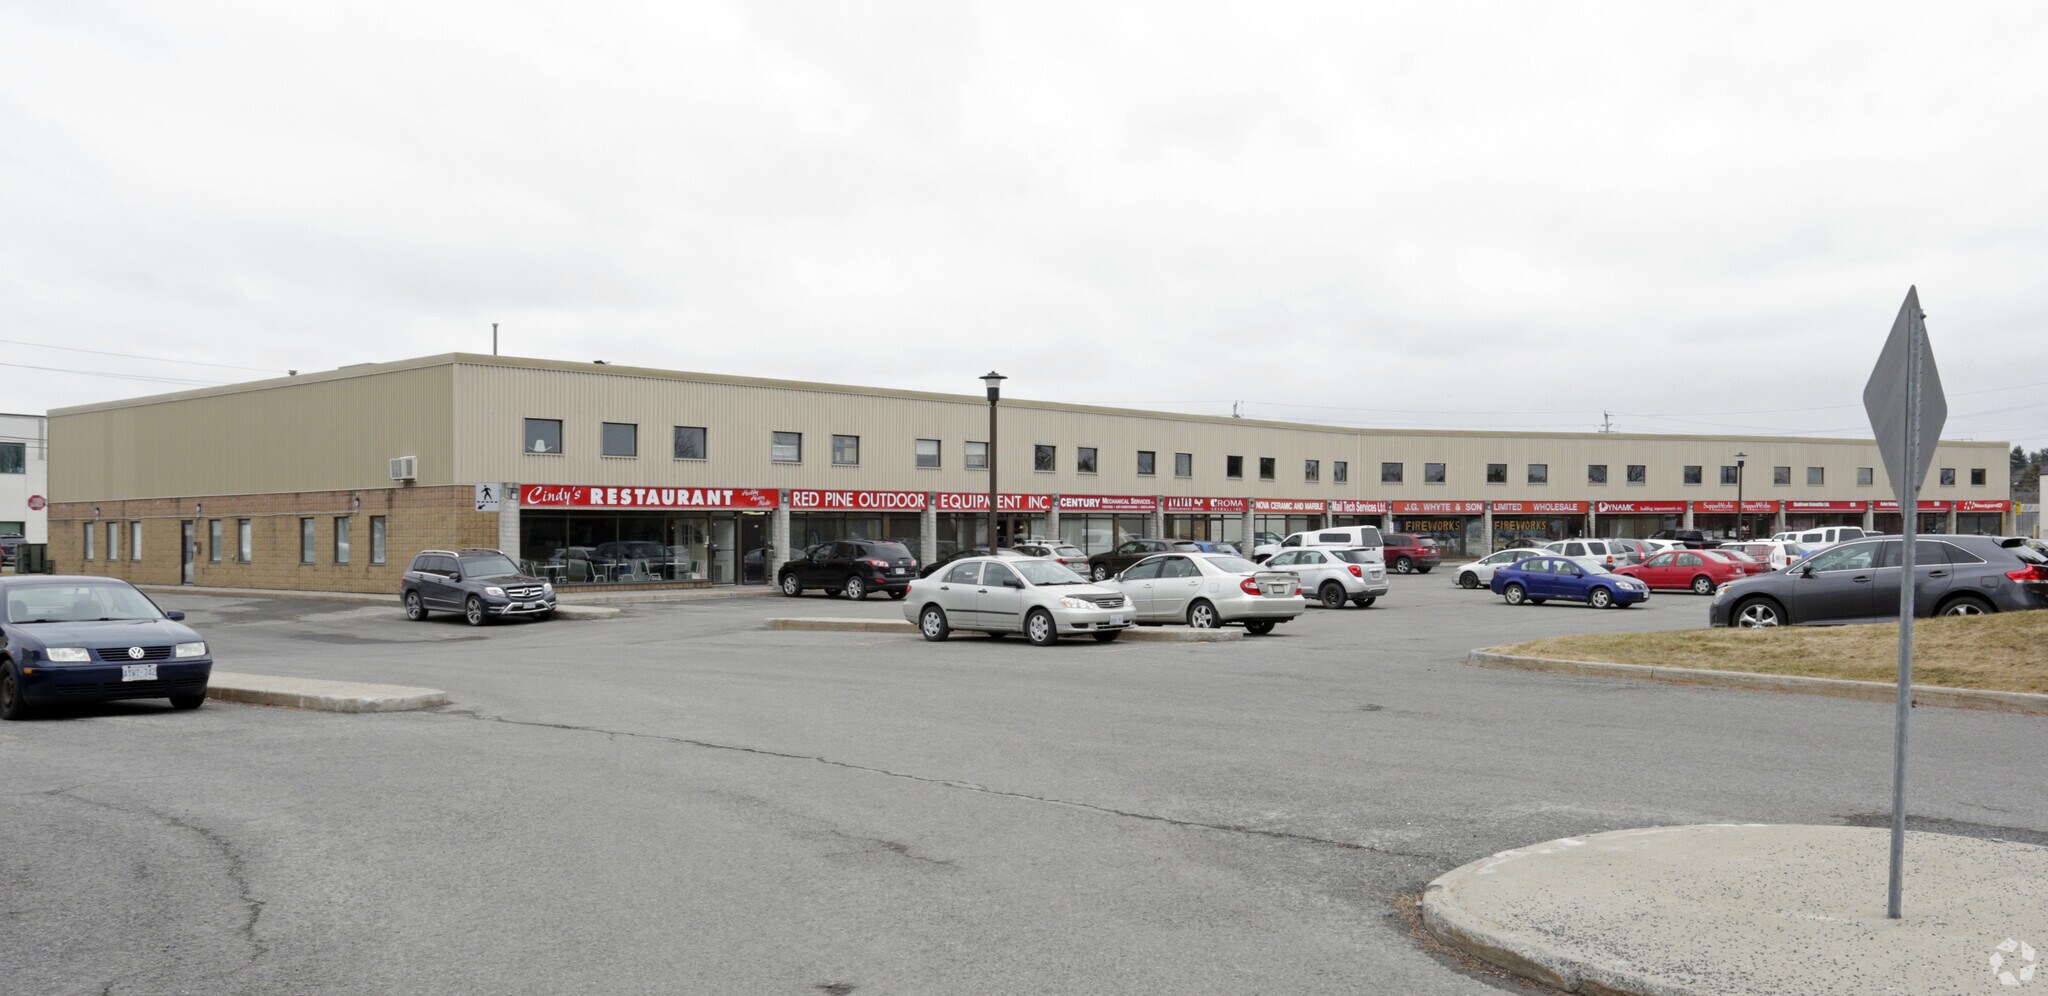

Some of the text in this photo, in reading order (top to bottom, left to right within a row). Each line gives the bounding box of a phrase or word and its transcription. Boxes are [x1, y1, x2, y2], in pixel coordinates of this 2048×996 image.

[527, 486, 733, 506] Cindy's RESTAURANT
[793, 491, 926, 508] RED PINE OUTDOOR
[1028, 496, 1051, 510] INC.
[1060, 497, 1100, 508] CENTURY
[1168, 498, 1192, 507] AVATAR
[1256, 501, 1324, 510] NOVA CERAMIC AND MARBLE
[1344, 501, 1356, 512] Tech
[1356, 502, 1377, 512] Services
[1404, 503, 1483, 511] J.G. WHYTE & SON
[1494, 503, 1577, 511] LIMITED WHOLESALE
[1598, 501, 1634, 512] DYNAMIC
[1405, 520, 1460, 531] FIREWORKS
[1494, 520, 1546, 531] FIREWORKS
